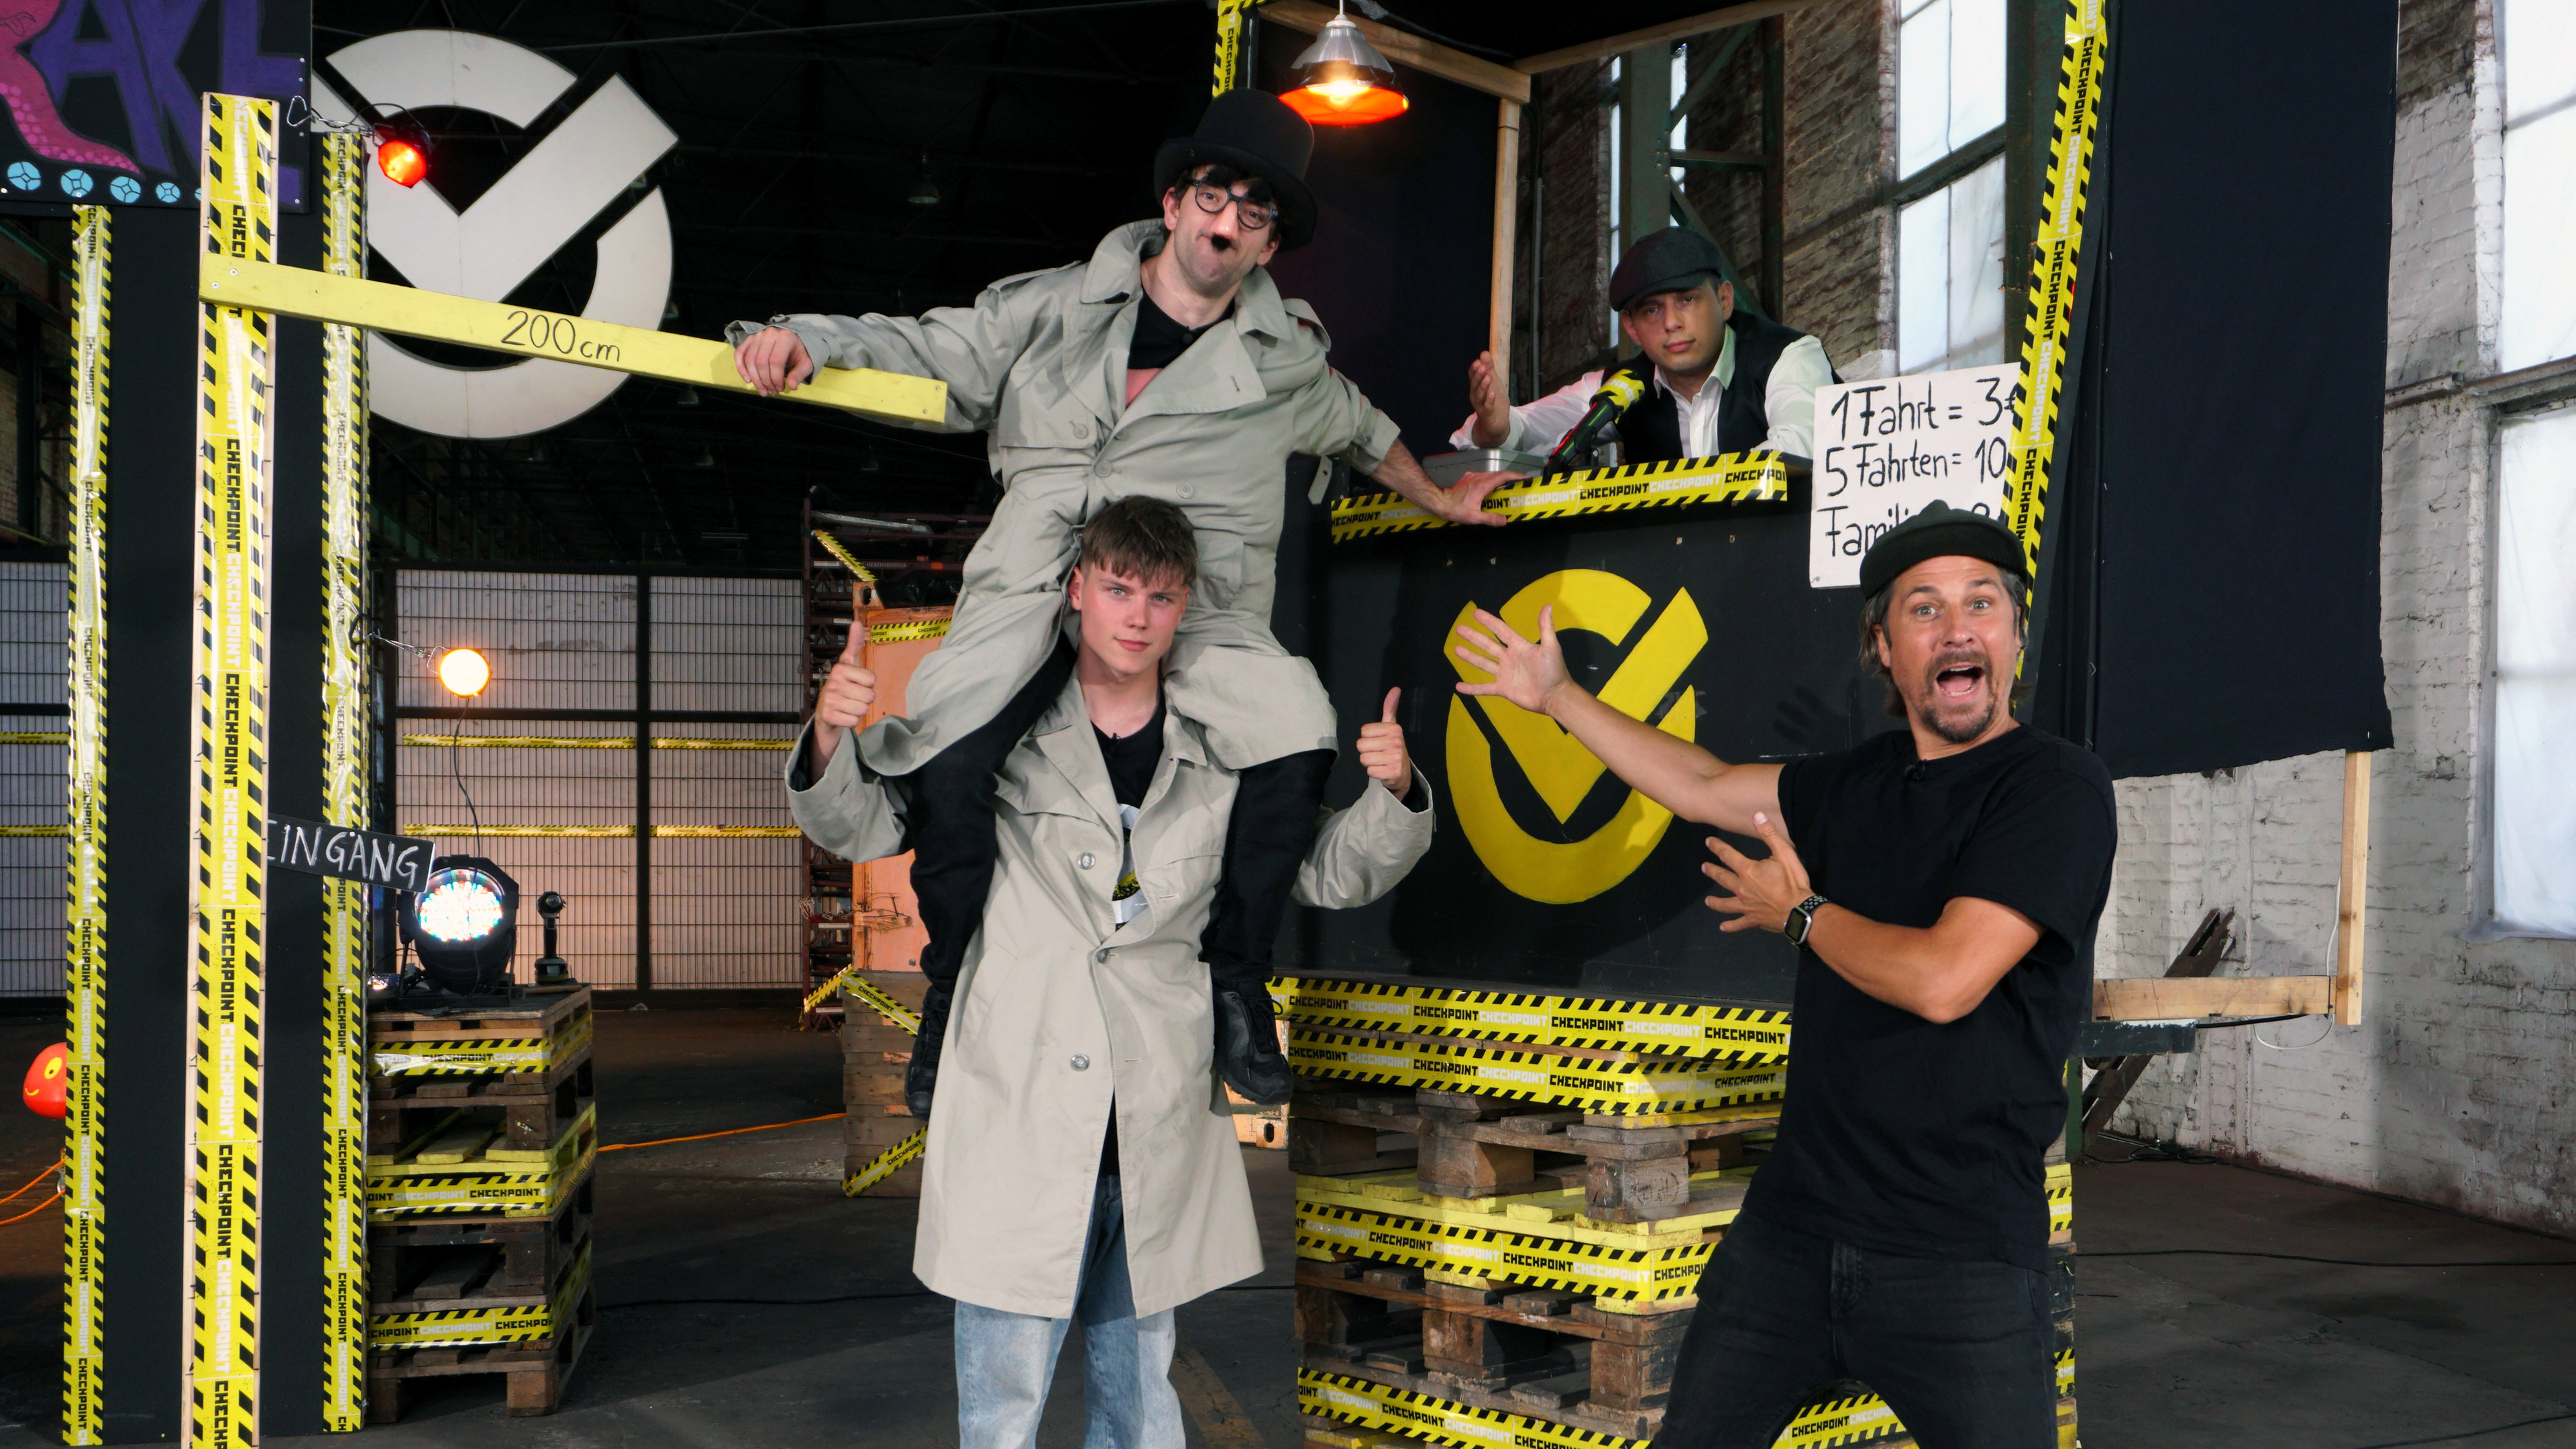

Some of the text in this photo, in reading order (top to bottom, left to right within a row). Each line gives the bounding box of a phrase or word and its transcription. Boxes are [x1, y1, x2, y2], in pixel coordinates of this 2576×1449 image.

[2070, 37, 2094, 135] CHECKPOINT
[233, 98, 250, 197] HECKPOINT
[337, 134, 346, 196] HECKPOINT
[2057, 135, 2080, 235] CHECKPOINT
[2043, 240, 2065, 339] CHECKPOINT
[227, 316, 244, 433] CHECKPOINT
[2029, 340, 2053, 442] CHECKPOINT
[1831, 390, 1849, 441] 1
[1851, 380, 1939, 436] Fahrt
[226, 438, 240, 552] CHECKPOINT
[1481, 468, 1786, 511] POINT CHECKPOINT CHECKPOINT CHECKPOINT CHECKPOI
[1825, 446, 1848, 496] 5
[1332, 511, 1381, 528] HECKPOINT
[83, 551, 94, 623] CHECKPOINT
[225, 553, 241, 667] CHECKPOINT
[83, 626, 93, 698] CHECKPOINT
[224, 674, 239, 787] CHECKPOINT
[82, 772, 93, 843] CHECKPOINT
[222, 788, 238, 903] CHECKPOINT
[337, 878, 346, 912] POINT
[81, 918, 92, 990] CHECKPOINT
[221, 908, 235, 1022] CHECKPOINT
[336, 912, 347, 982] CHECKPOINT
[80, 989, 92, 1062] CHECKPOINT
[336, 985, 346, 1055] CHECKPOINT
[857, 985, 894, 1012] CHECKPOINT
[1289, 995, 1348, 1010] CHECKPOINT
[1348, 1000, 1411, 1016] CHECKPOINT
[1413, 1005, 1479, 1022] CHECKPOINT
[1479, 1010, 1548, 1027] CHECKPOINT
[1552, 1016, 1624, 1032] CHECKPOINT
[1623, 1021, 1701, 1037] CHECKPOINT
[1705, 1026, 1786, 1044] CHECKPOINT
[219, 1022, 236, 1138] CHECKPOINT
[337, 1055, 349, 1126] CHECKPOINT
[422, 1053, 494, 1063] CHECKPOINT
[1288, 1046, 1348, 1062] CHECKPOINT
[1347, 1051, 1411, 1069] CHECKPOINT
[1413, 1059, 1479, 1076] CHECKPOINT
[1478, 1065, 1547, 1084] CHECKPOINT
[1550, 1074, 1624, 1092] CHECKPOINT
[1623, 1079, 1696, 1094] CHECKPOINT
[1715, 1073, 1776, 1089] CHECKPOINT
[80, 1064, 91, 1136] CHECKPOINT
[80, 1136, 91, 1208] CHECKPOINT
[337, 1129, 347, 1199] CHECKPOINT
[886, 1140, 922, 1165] CHECKPOINT
[217, 1144, 233, 1258] CHECKPOINT
[392, 1189, 466, 1201] CHECKPOINT
[470, 1187, 541, 1198] CHECKPOINT
[78, 1209, 89, 1283] CHECKPOINT
[337, 1199, 348, 1269] CHECKPOINT
[1305, 1220, 1368, 1240] CHECKPOINT
[1368, 1231, 1433, 1252] CHECKPOINT
[1432, 1241, 1500, 1263] CHECKPOINT
[1503, 1252, 1574, 1273] CHECKPOINT
[1573, 1262, 1651, 1283] CHECKPOINT
[1654, 1263, 1707, 1281] CHECKPOI
[78, 1282, 89, 1355] CHECKPOINT
[215, 1258, 232, 1375] CHECKPOINT
[337, 1273, 347, 1342] CHECKPOINT
[419, 1322, 492, 1335] CHECKPOINT
[76, 1357, 88, 1430] CHECKPOINT
[337, 1342, 348, 1413] CHECKPOINT
[213, 1379, 229, 1449] CHECKP
[1318, 1387, 1379, 1411] CHECKPOINT
[1382, 1402, 1444, 1428] CHECKPOINT
[1444, 1418, 1511, 1444] CHECKPOINT
[1792, 1415, 1849, 1438] CHECKPOINT
